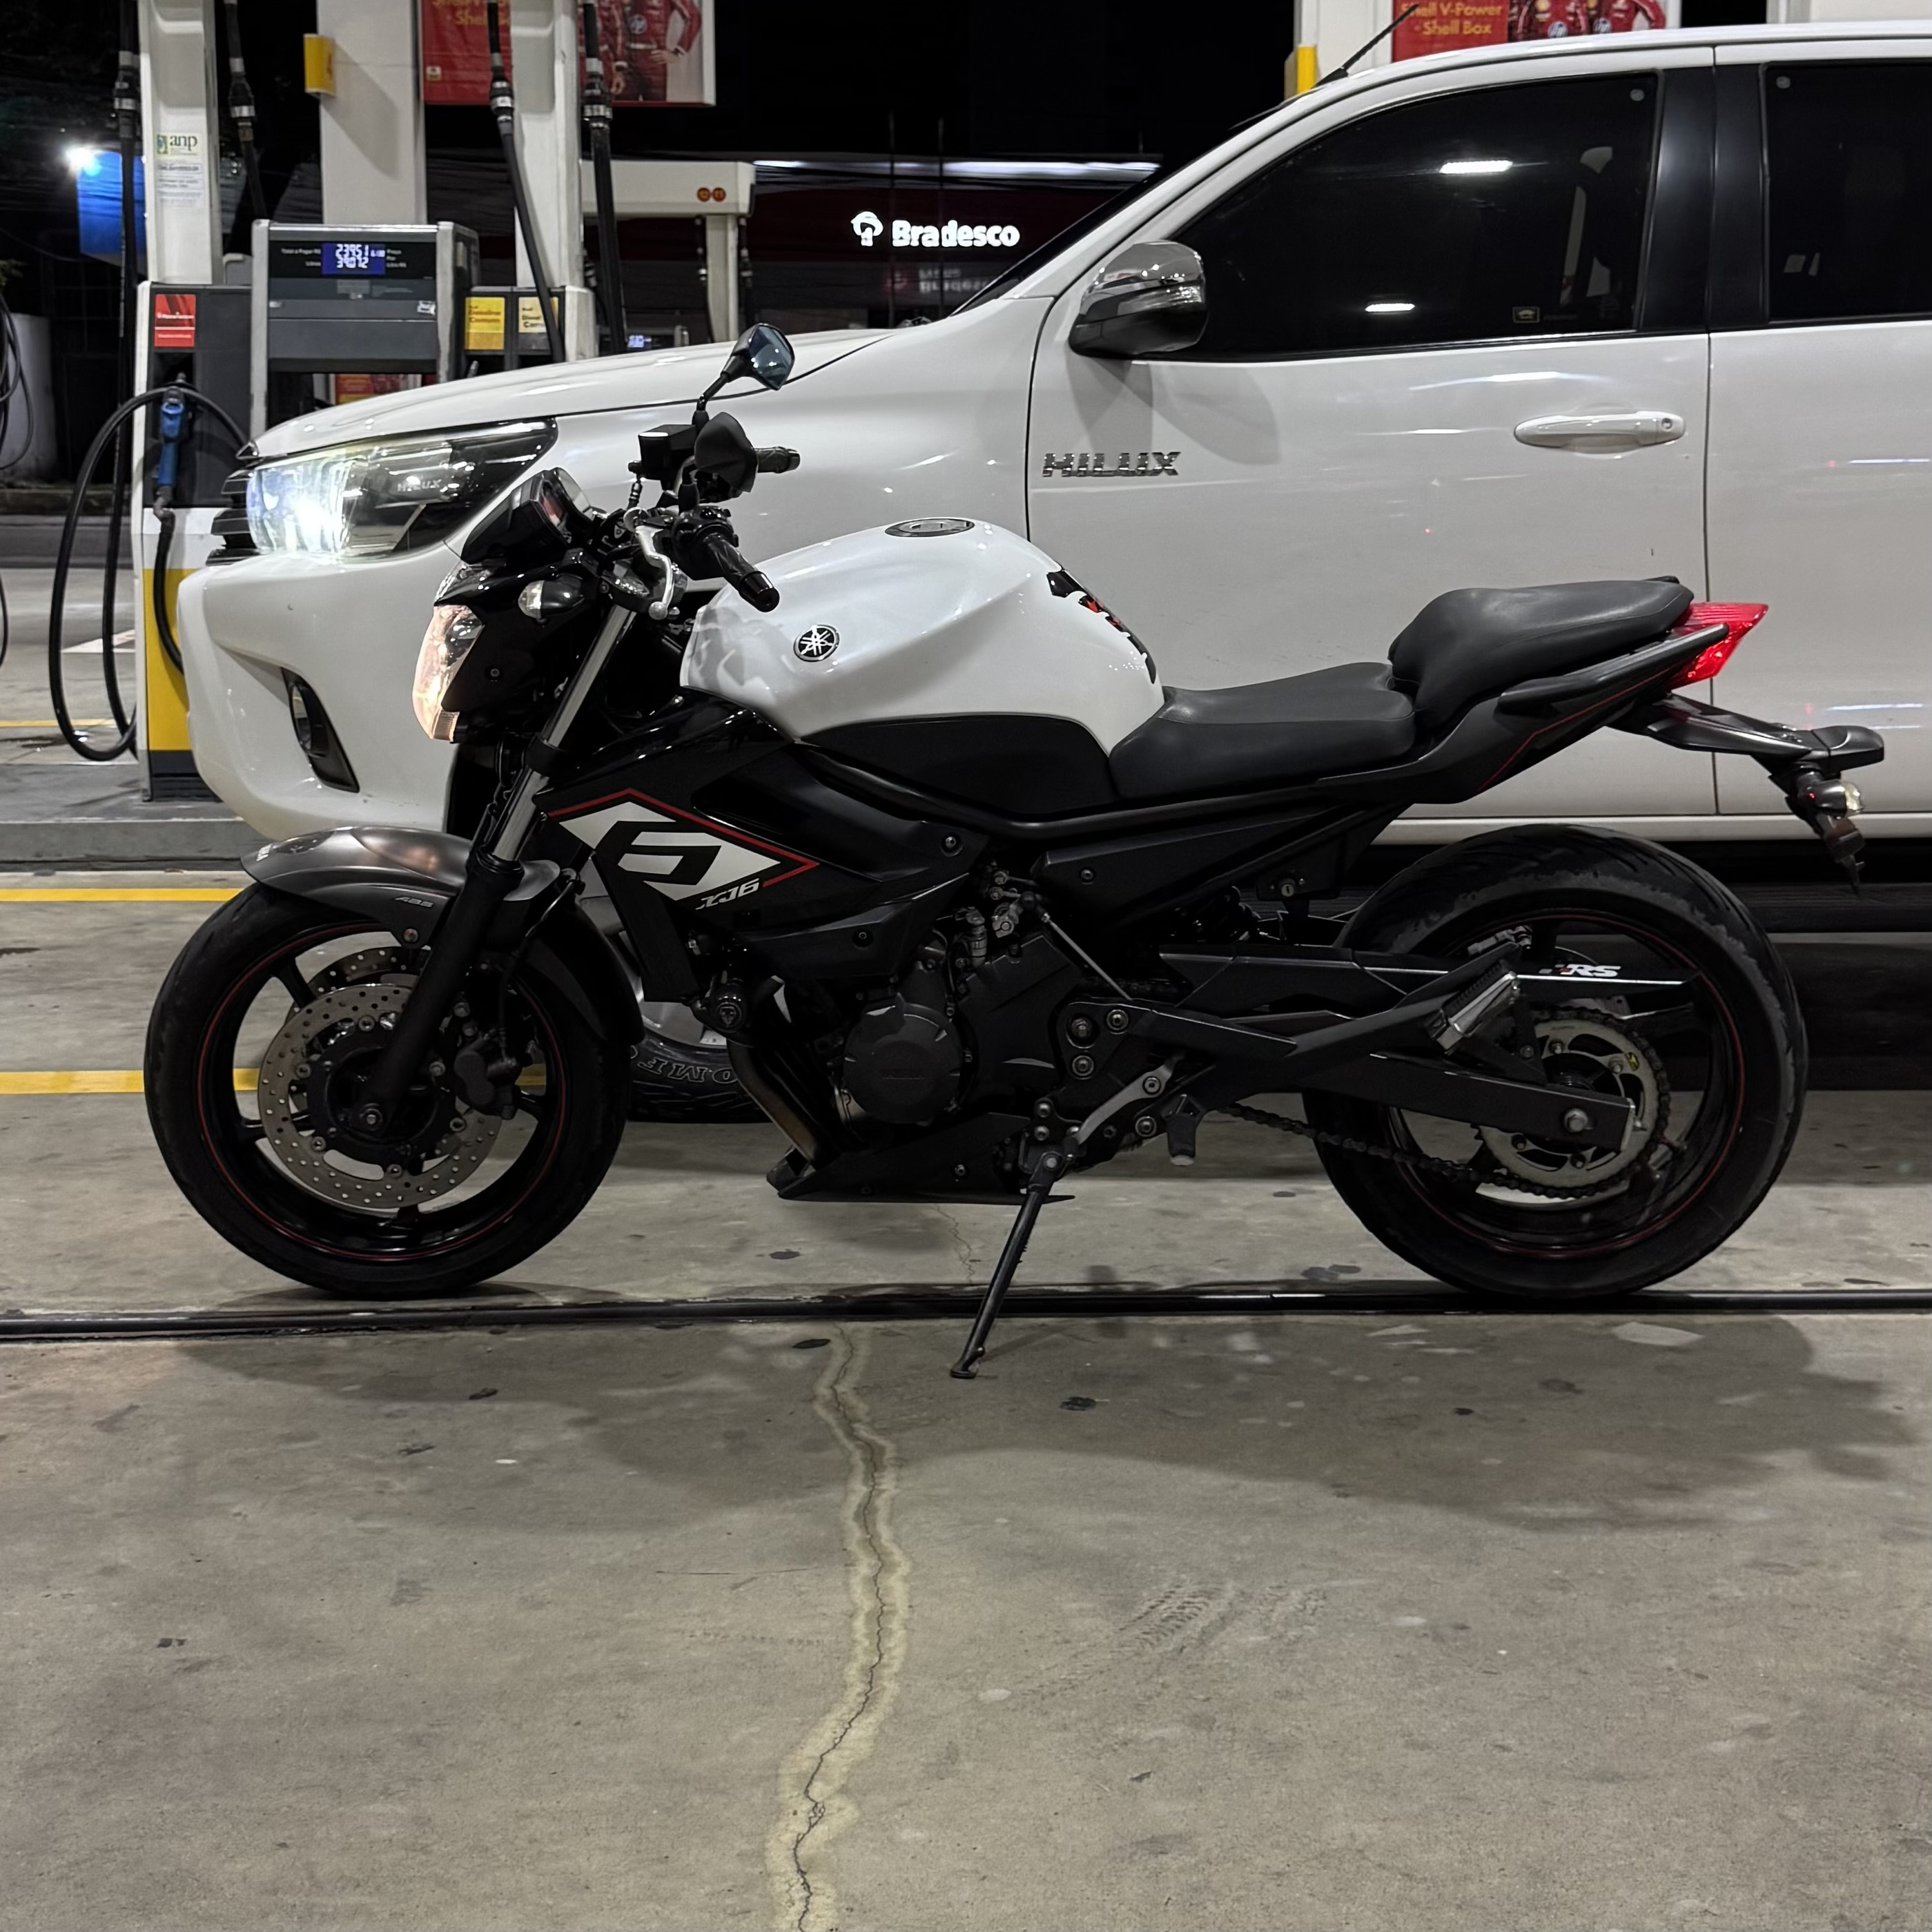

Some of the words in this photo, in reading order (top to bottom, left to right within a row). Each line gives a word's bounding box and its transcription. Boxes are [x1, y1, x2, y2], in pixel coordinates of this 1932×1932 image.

[1439, 2, 1503, 17] V-Power
[1423, 19, 1460, 35] Shell
[1463, 21, 1492, 34] Box
[170, 135, 198, 152] anp
[892, 219, 1020, 247] Bradesco
[1042, 451, 1181, 477] HILUX
[695, 878, 760, 910] XJ6
